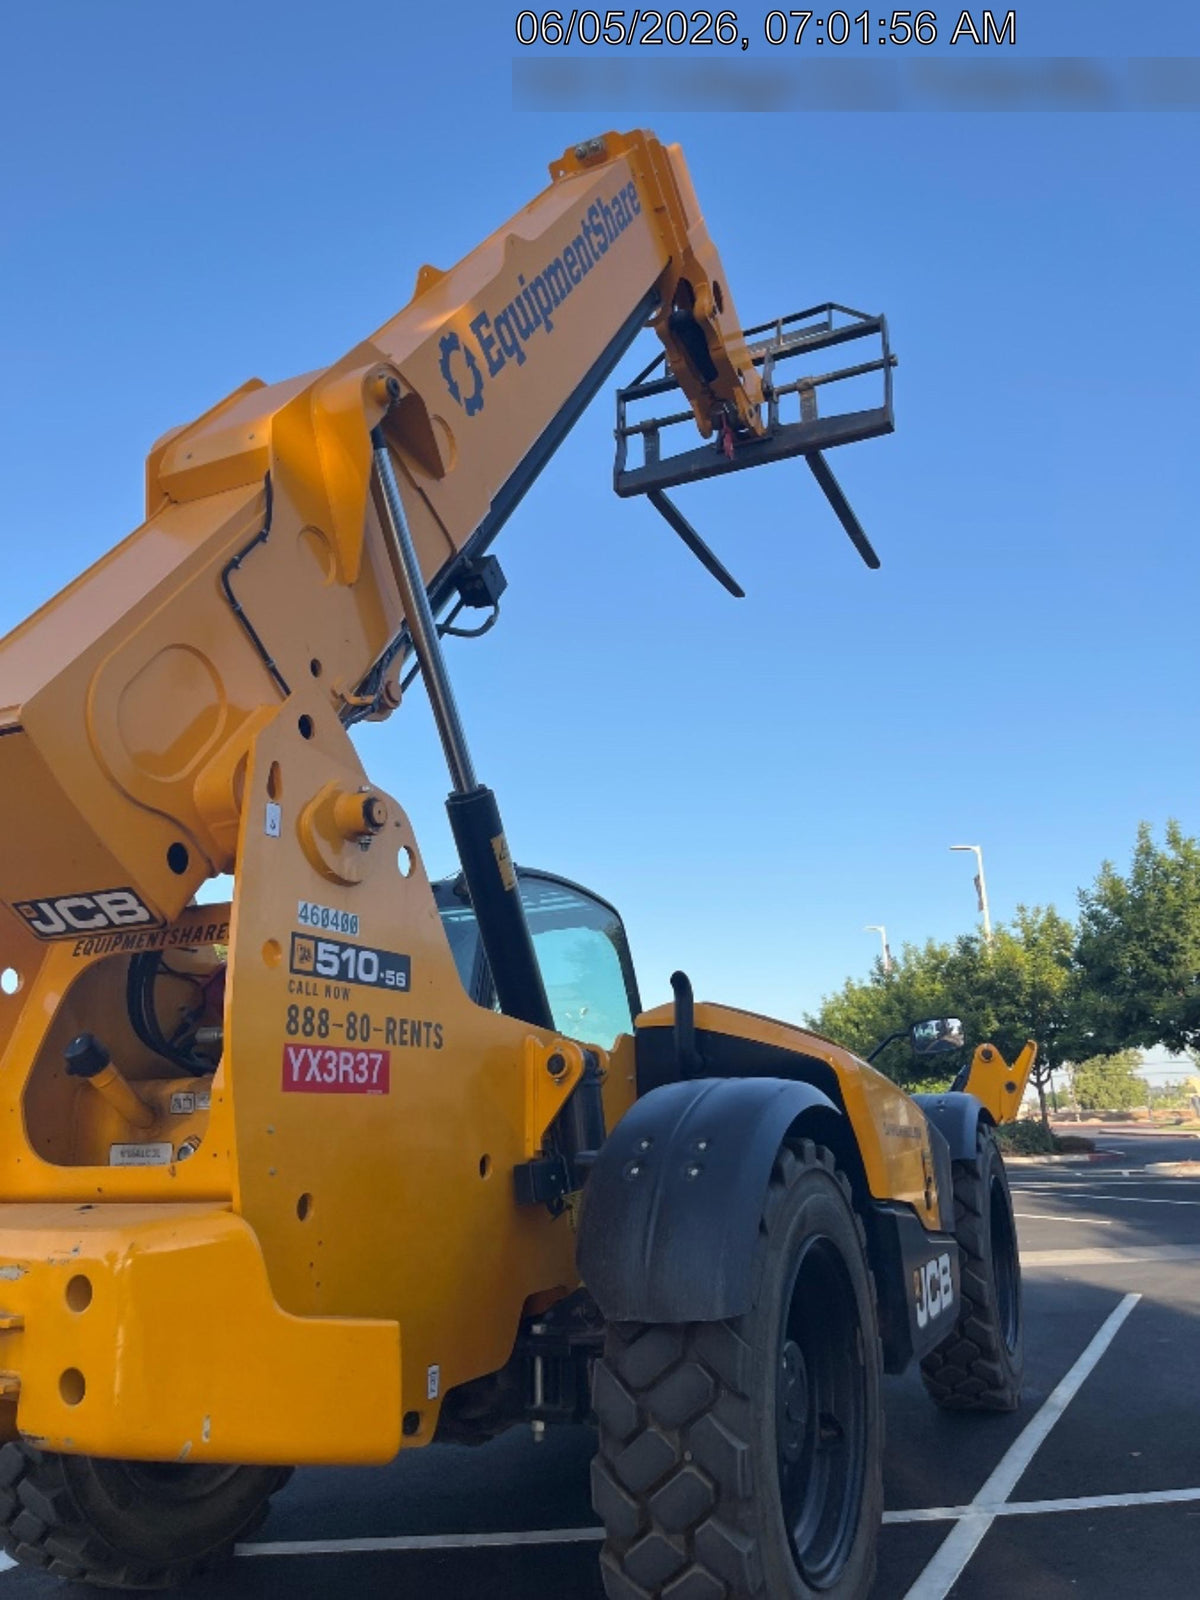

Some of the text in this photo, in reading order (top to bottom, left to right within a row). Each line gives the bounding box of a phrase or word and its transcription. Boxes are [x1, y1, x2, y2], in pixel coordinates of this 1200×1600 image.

[469, 181, 641, 378] EquipmentShare
[31, 891, 150, 934] JCB
[299, 903, 358, 934] 460400
[288, 980, 351, 1000] CALL NOW
[286, 1004, 444, 1049] 888-80-RENTS
[287, 1047, 383, 1084] YX3R37
[915, 1252, 954, 1329] JCB
